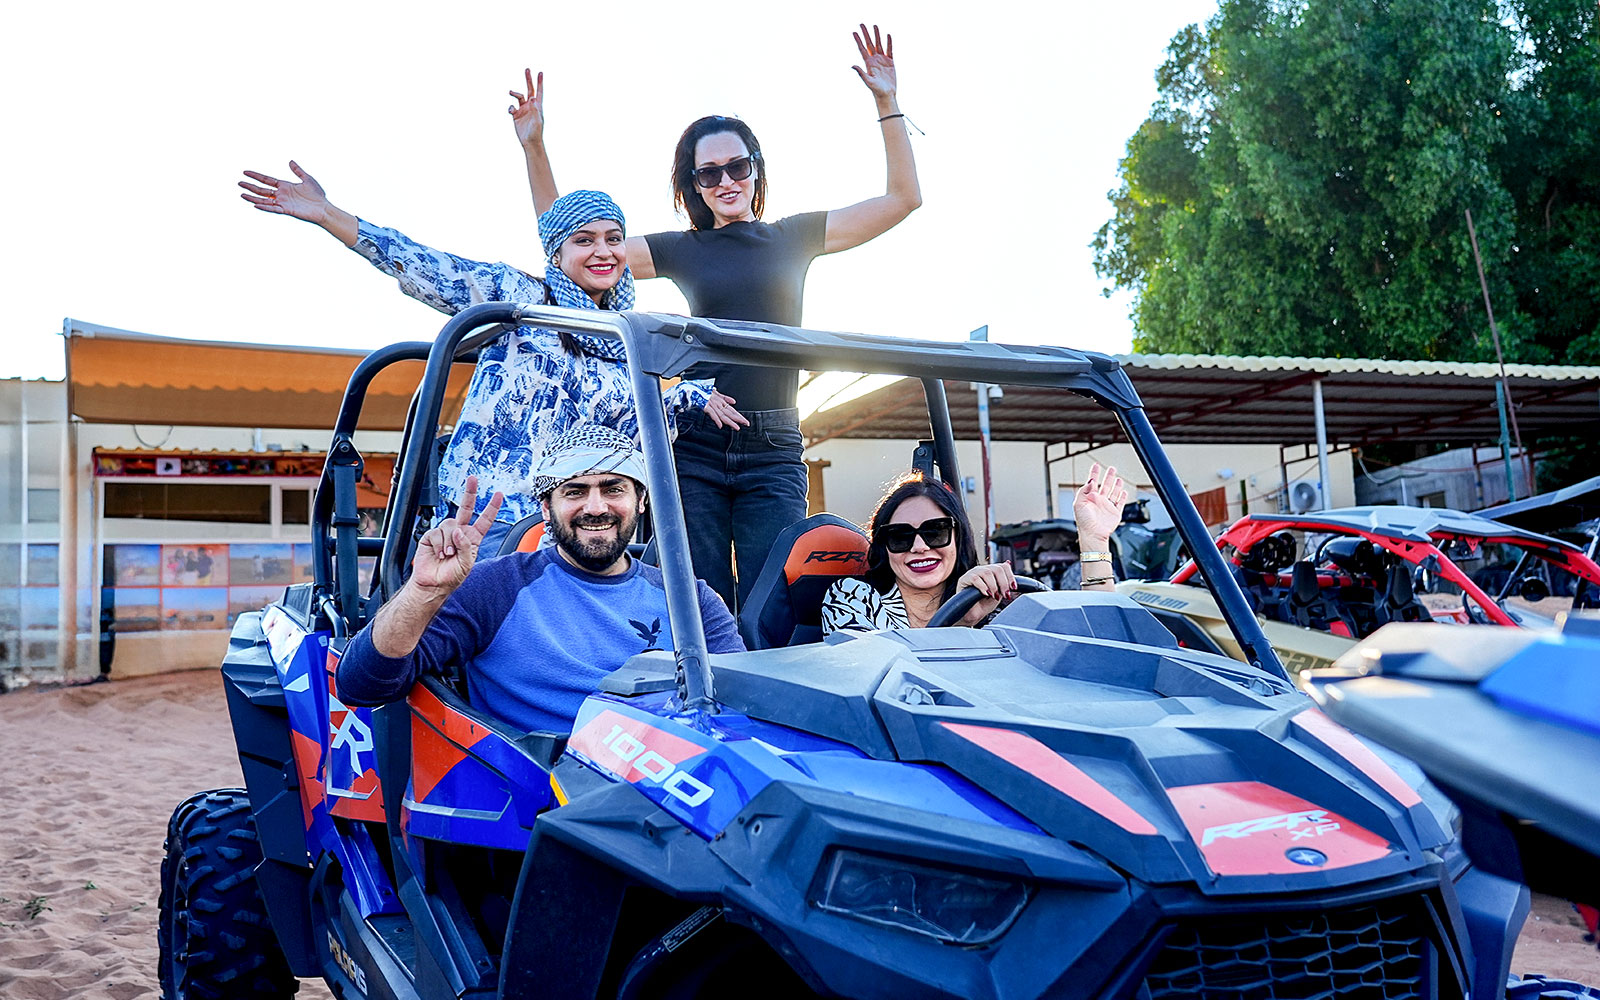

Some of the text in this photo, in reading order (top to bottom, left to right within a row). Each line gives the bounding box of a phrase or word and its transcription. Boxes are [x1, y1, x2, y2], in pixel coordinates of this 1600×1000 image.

[804, 551, 866, 563] RZR
[602, 724, 715, 807] 1000
[1201, 810, 1333, 847] RZR
[1290, 823, 1341, 841] XP
[327, 930, 368, 996] POLARIS
